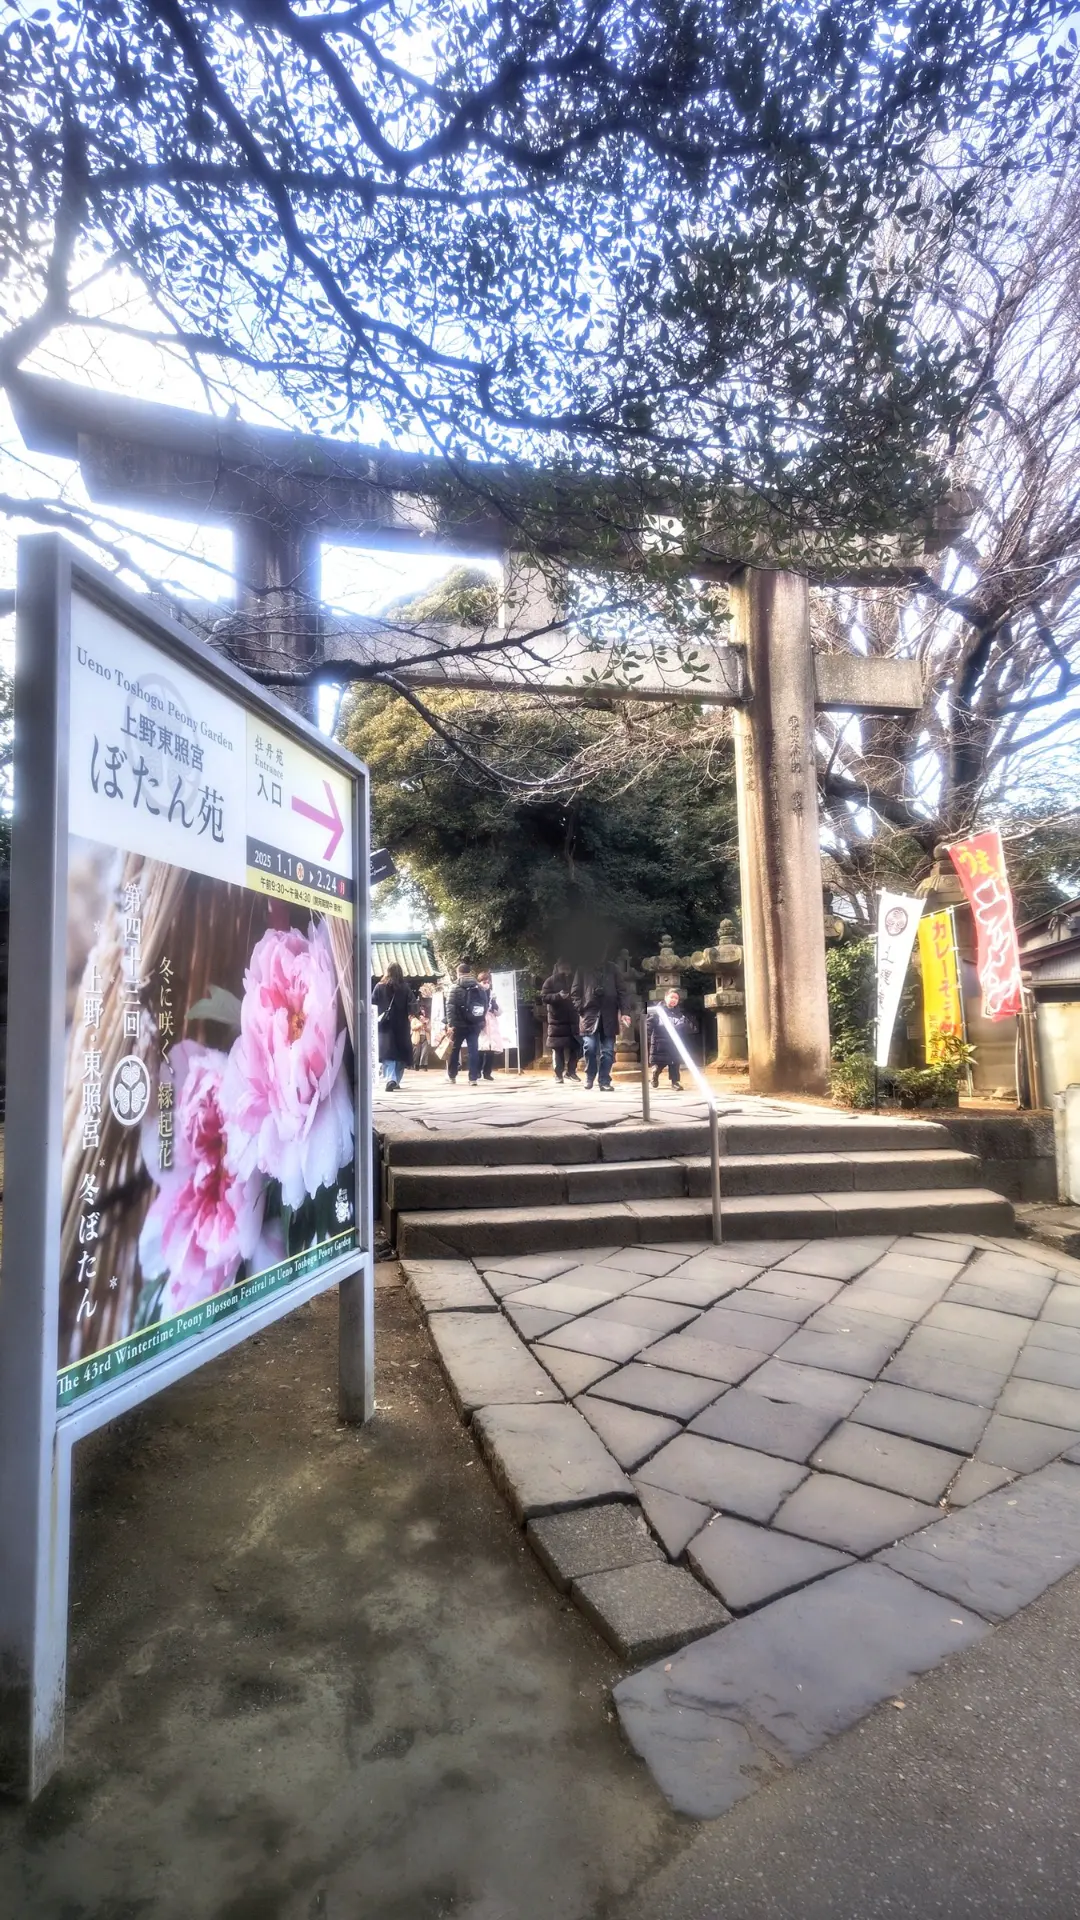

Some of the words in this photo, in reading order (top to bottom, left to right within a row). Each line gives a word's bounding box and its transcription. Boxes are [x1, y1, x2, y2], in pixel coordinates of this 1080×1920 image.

[77, 646, 111, 681] Ueno
[115, 669, 164, 711] Toshogu
[167, 700, 198, 731] Peony
[200, 721, 233, 751] Garden
[120, 705, 204, 773] 上野東照宮
[254, 734, 284, 767] 牡丹苑
[91, 734, 225, 843] ぼたん苑
[254, 753, 284, 780] Entrance
[257, 773, 282, 808] 入口
[254, 850, 272, 868] 2025
[316, 870, 337, 893] 2.24
[123, 882, 142, 1039] 第四十三回
[158, 956, 175, 1169] 冬に咲く、縁起花
[76, 1173, 101, 1322] 冬ぼたん
[57, 1374, 80, 1396] The
[83, 1354, 112, 1382] 43rd
[115, 1327, 174, 1365] Wintertime
[176, 1311, 203, 1334] Peony
[206, 1294, 238, 1319] Blossom
[240, 1277, 267, 1300] Festival
[268, 1275, 276, 1286] in
[277, 1266, 293, 1281] Ueno
[294, 1255, 317, 1271] Toshogu
[318, 1246, 333, 1260] Peony
[334, 1236, 351, 1250] Garden
